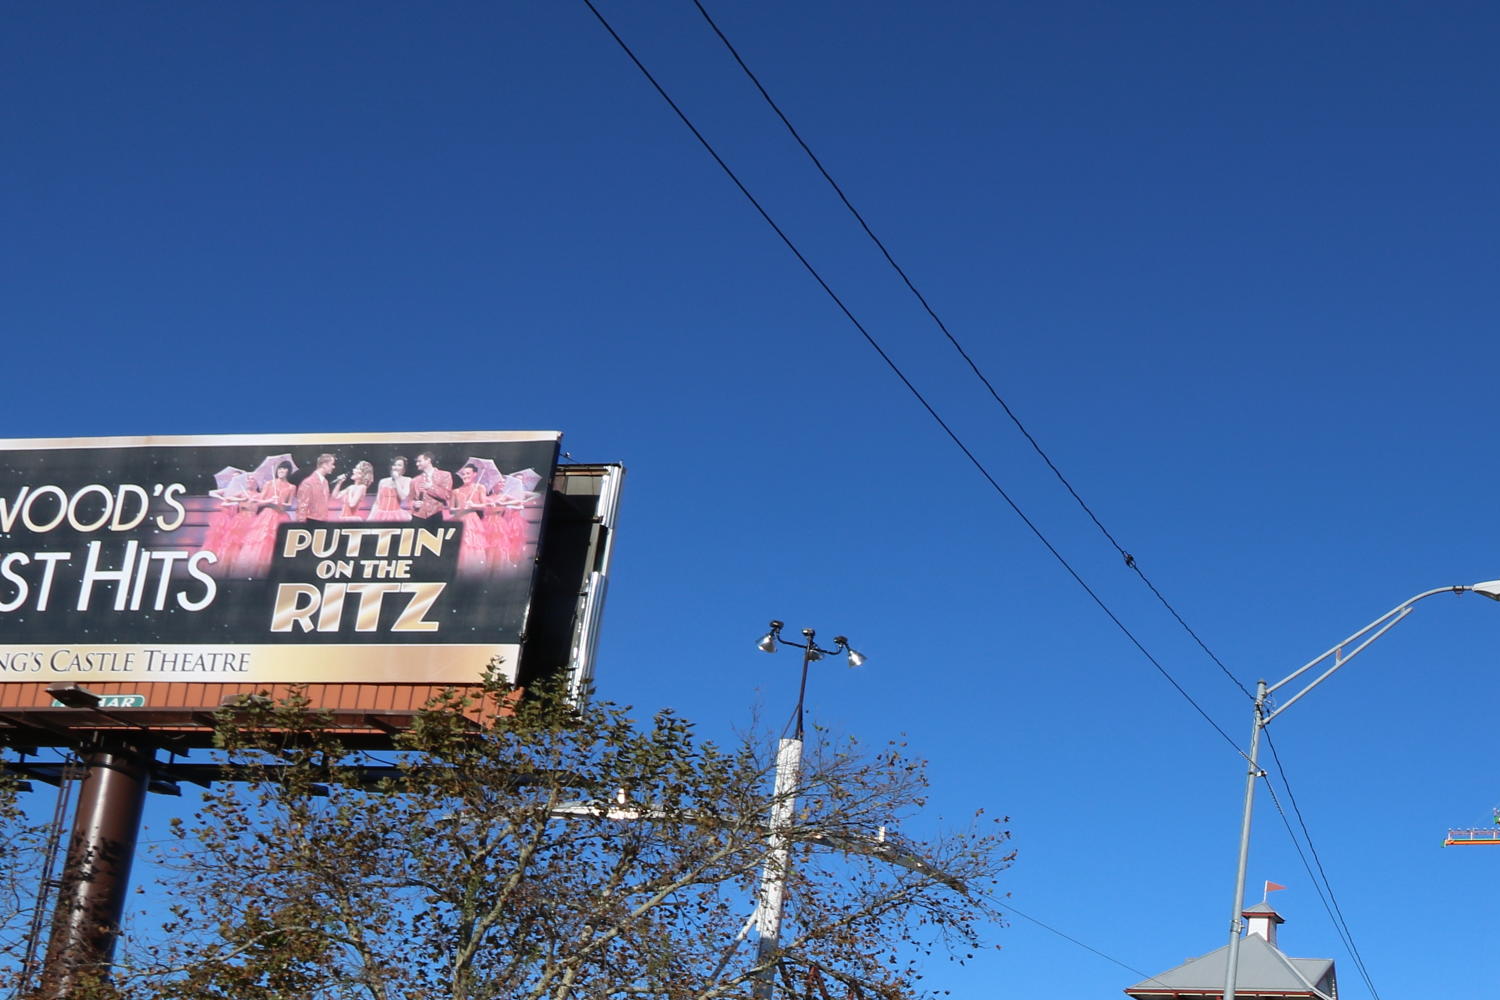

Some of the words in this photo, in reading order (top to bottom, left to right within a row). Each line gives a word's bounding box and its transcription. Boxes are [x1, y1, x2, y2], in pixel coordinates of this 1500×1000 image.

[283, 528, 456, 558] PUTTIN'
[0, 552, 71, 612] ST
[77, 540, 218, 612] HITS
[316, 560, 354, 579] ON
[360, 560, 413, 578] THE
[270, 582, 447, 633] RITZ
[50, 650, 136, 673] CASTLE
[144, 650, 250, 673] THEATRE
